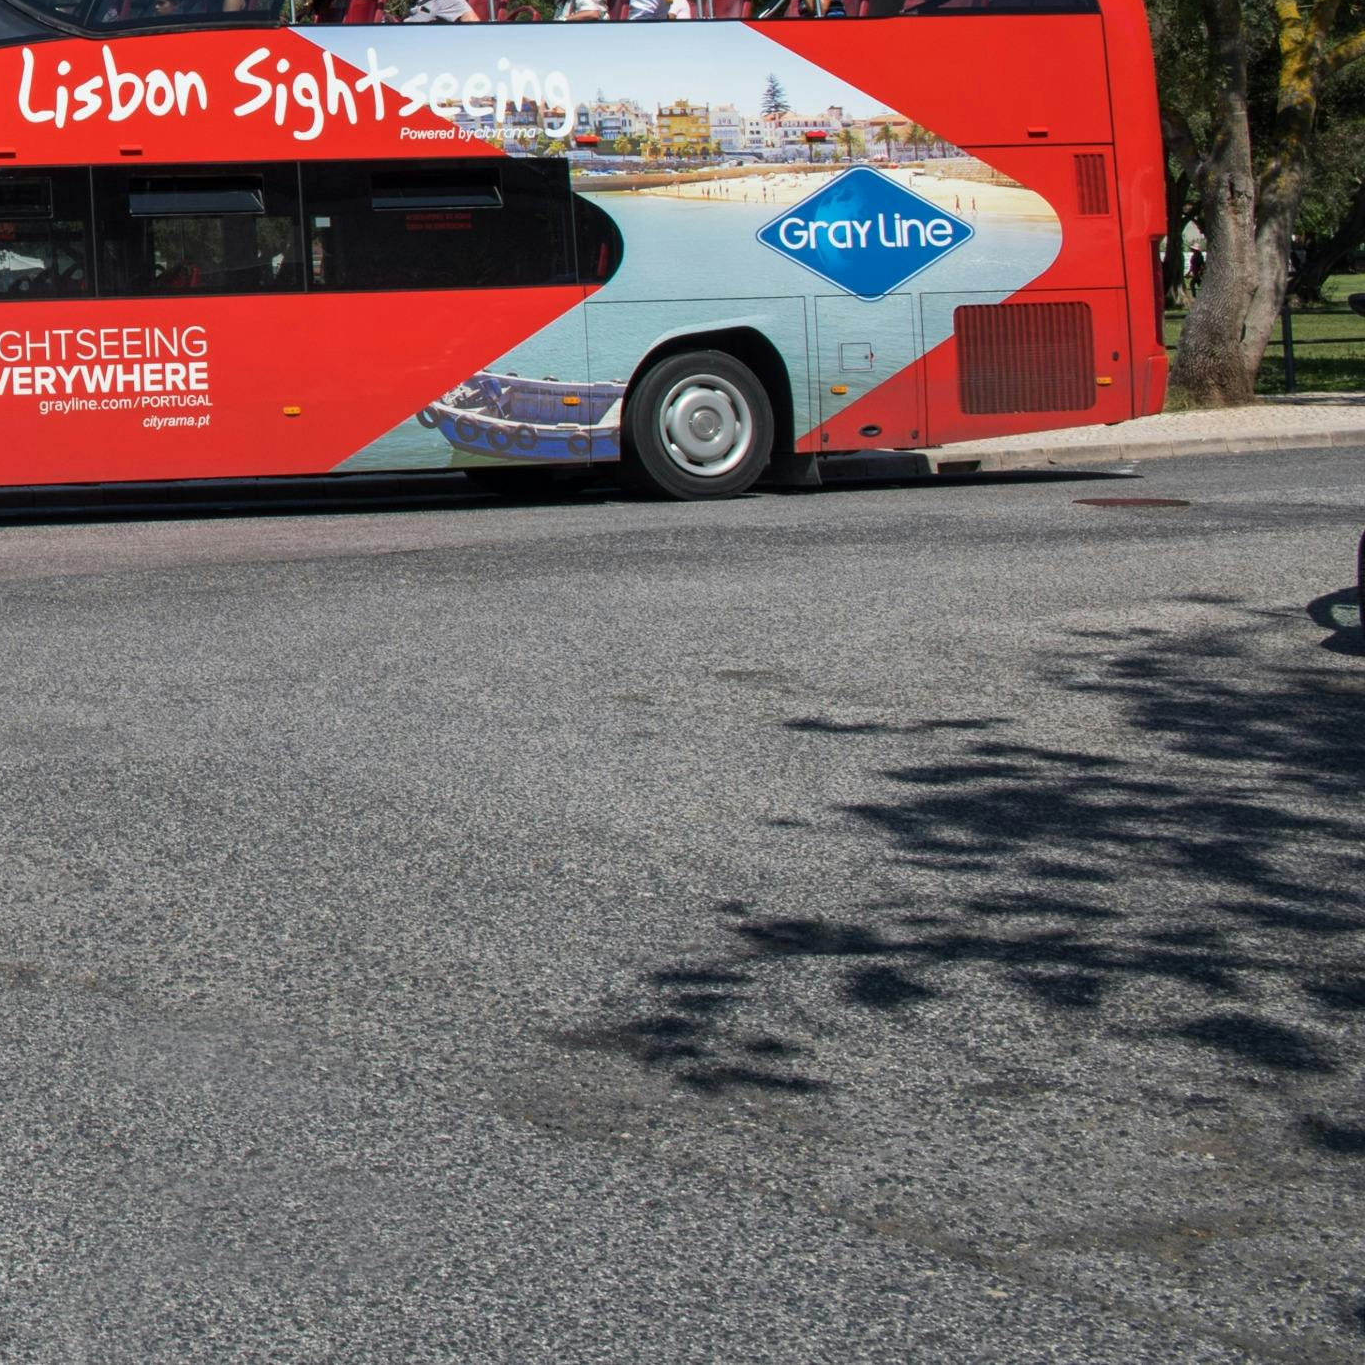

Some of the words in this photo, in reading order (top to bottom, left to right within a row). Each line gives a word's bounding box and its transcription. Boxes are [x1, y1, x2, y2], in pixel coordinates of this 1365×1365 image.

[18, 46, 208, 129] Lisbon
[233, 46, 575, 141] Sightseeing
[400, 126, 455, 139] Powered
[458, 126, 475, 142] by
[474, 125, 536, 140] cityrama
[779, 216, 872, 250] Gray
[877, 212, 953, 249] Line
[142, 413, 211, 431] cityrama.pt
